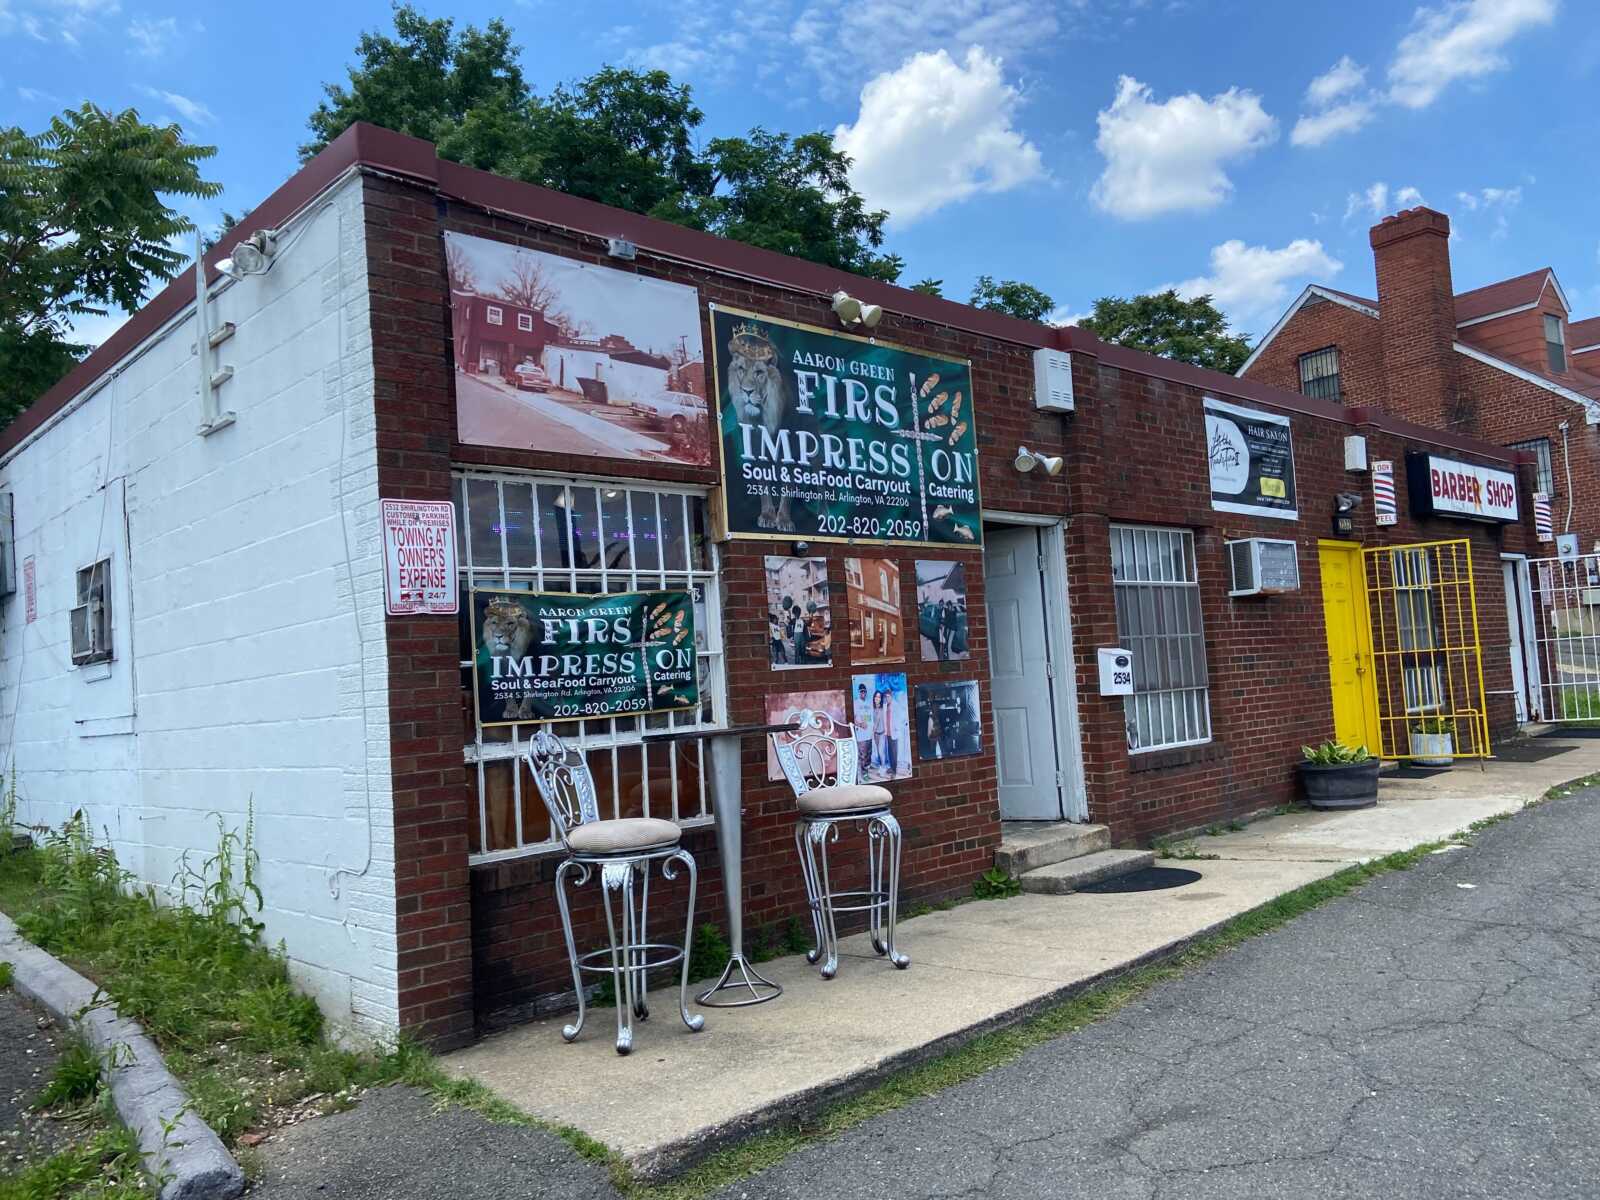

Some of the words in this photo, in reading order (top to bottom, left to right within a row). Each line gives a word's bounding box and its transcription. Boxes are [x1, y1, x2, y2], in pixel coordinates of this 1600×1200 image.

[793, 350, 845, 371] AARON
[850, 361, 895, 382] GREEN
[1248, 425, 1265, 437] HAIR
[1265, 429, 1288, 442] SALON
[742, 463, 777, 482] Soul
[780, 469, 791, 482] &
[793, 468, 852, 489] SeaFood
[855, 474, 911, 496] Carryout
[1431, 468, 1481, 504] BARBER
[1487, 479, 1514, 508] SHOP
[746, 484, 769, 496] 2534
[771, 486, 779, 497] S.
[780, 486, 823, 502] Shirlington
[824, 489, 837, 501] Rd.
[838, 491, 874, 505] Arlington,
[874, 494, 885, 505] VA
[886, 496, 909, 507] 22206
[928, 482, 974, 503] Catering
[386, 511, 419, 520] CUSTOMER
[400, 504, 439, 512] SHIRLINGTON
[817, 514, 921, 537] 202-820-2059
[391, 527, 433, 546] TOWING
[436, 528, 447, 546] AT
[398, 548, 446, 567] OWNER'S
[400, 568, 446, 588] EXPENSE
[428, 591, 447, 599] 24/7
[539, 607, 585, 617] AARON
[590, 605, 632, 616] GREEN
[491, 679, 520, 690] Soul
[523, 679, 532, 689] &
[533, 676, 586, 688] SeaFood
[589, 674, 637, 688] Carryout
[654, 670, 691, 681] Catering
[1113, 672, 1131, 685] 2534
[494, 692, 514, 700] 2534
[523, 689, 559, 699] Shirlington
[603, 686, 613, 694] VA
[613, 685, 636, 693] 22206
[553, 698, 647, 717] 202-820-2059
